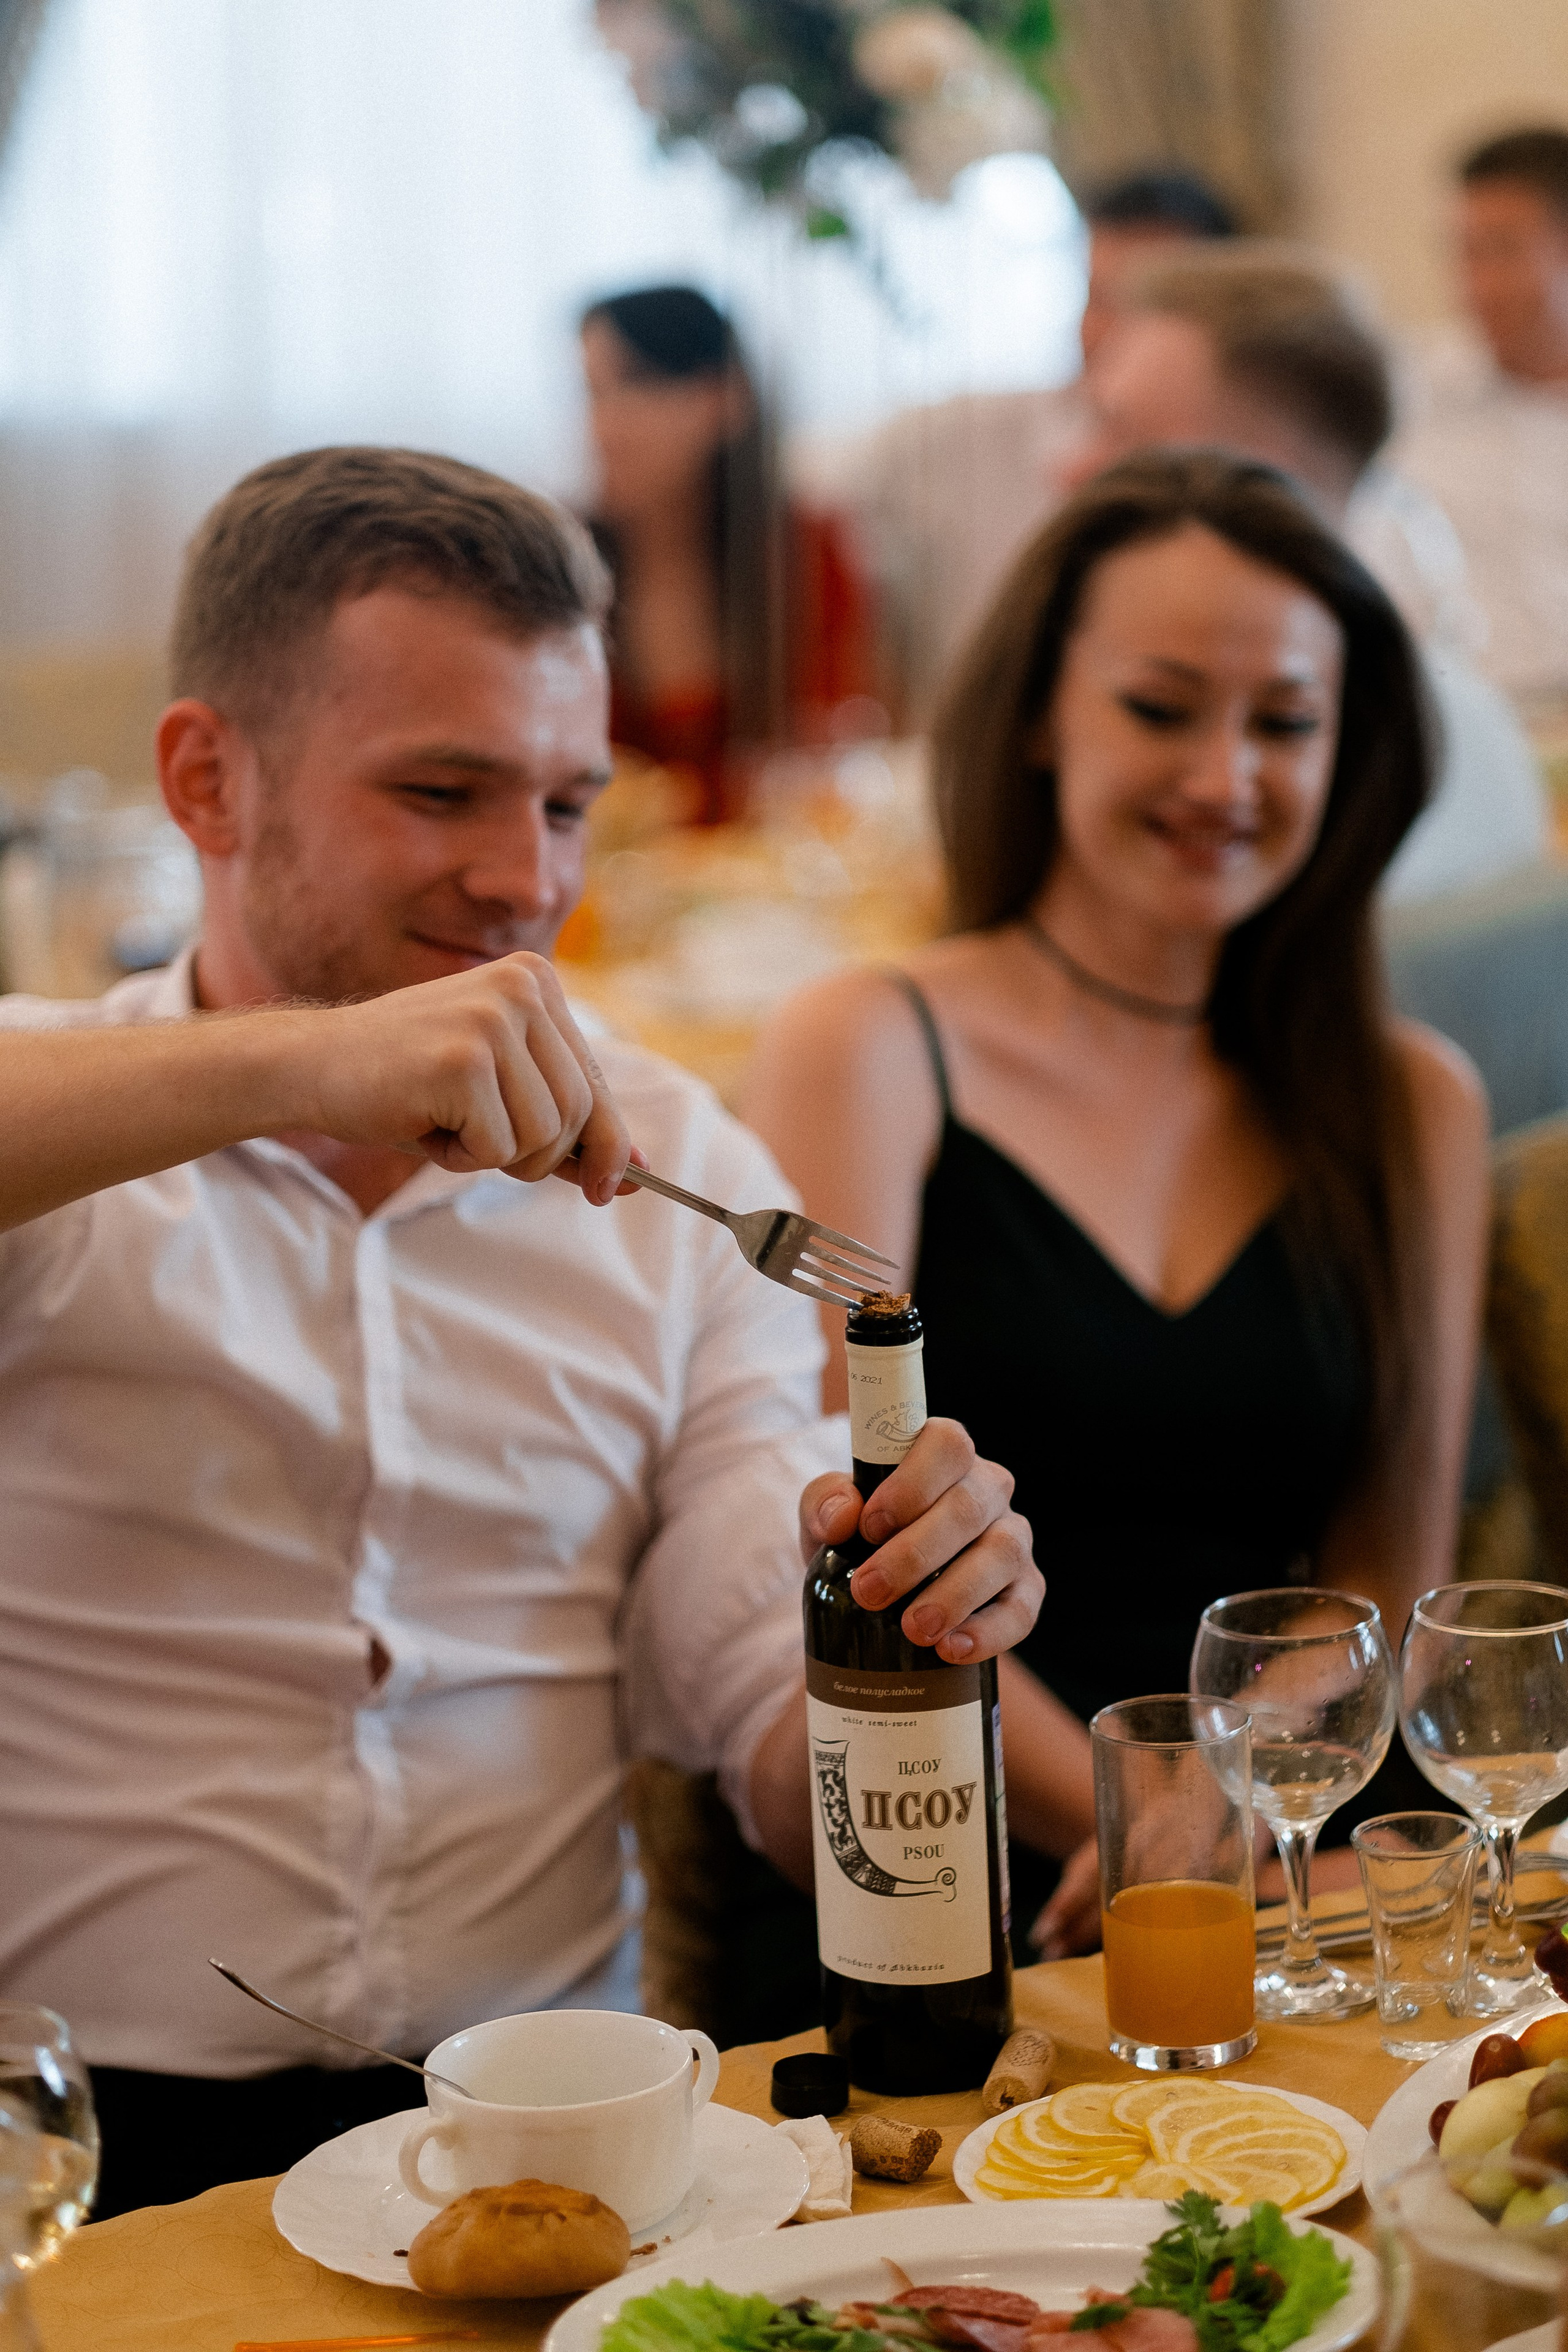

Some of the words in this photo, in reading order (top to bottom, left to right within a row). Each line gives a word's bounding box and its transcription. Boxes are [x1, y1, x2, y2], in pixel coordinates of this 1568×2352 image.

[860, 1374, 883, 1385] 2021
[864, 1408, 888, 1430] WINES
[892, 1444, 914, 1452] ABK
[833, 1681, 859, 1694] белое
[859, 1686, 925, 1698] полусладкое
[842, 1716, 863, 1725] white
[861, 1781, 977, 1831] ПСОУ
[902, 1844, 946, 1860] PSOU
